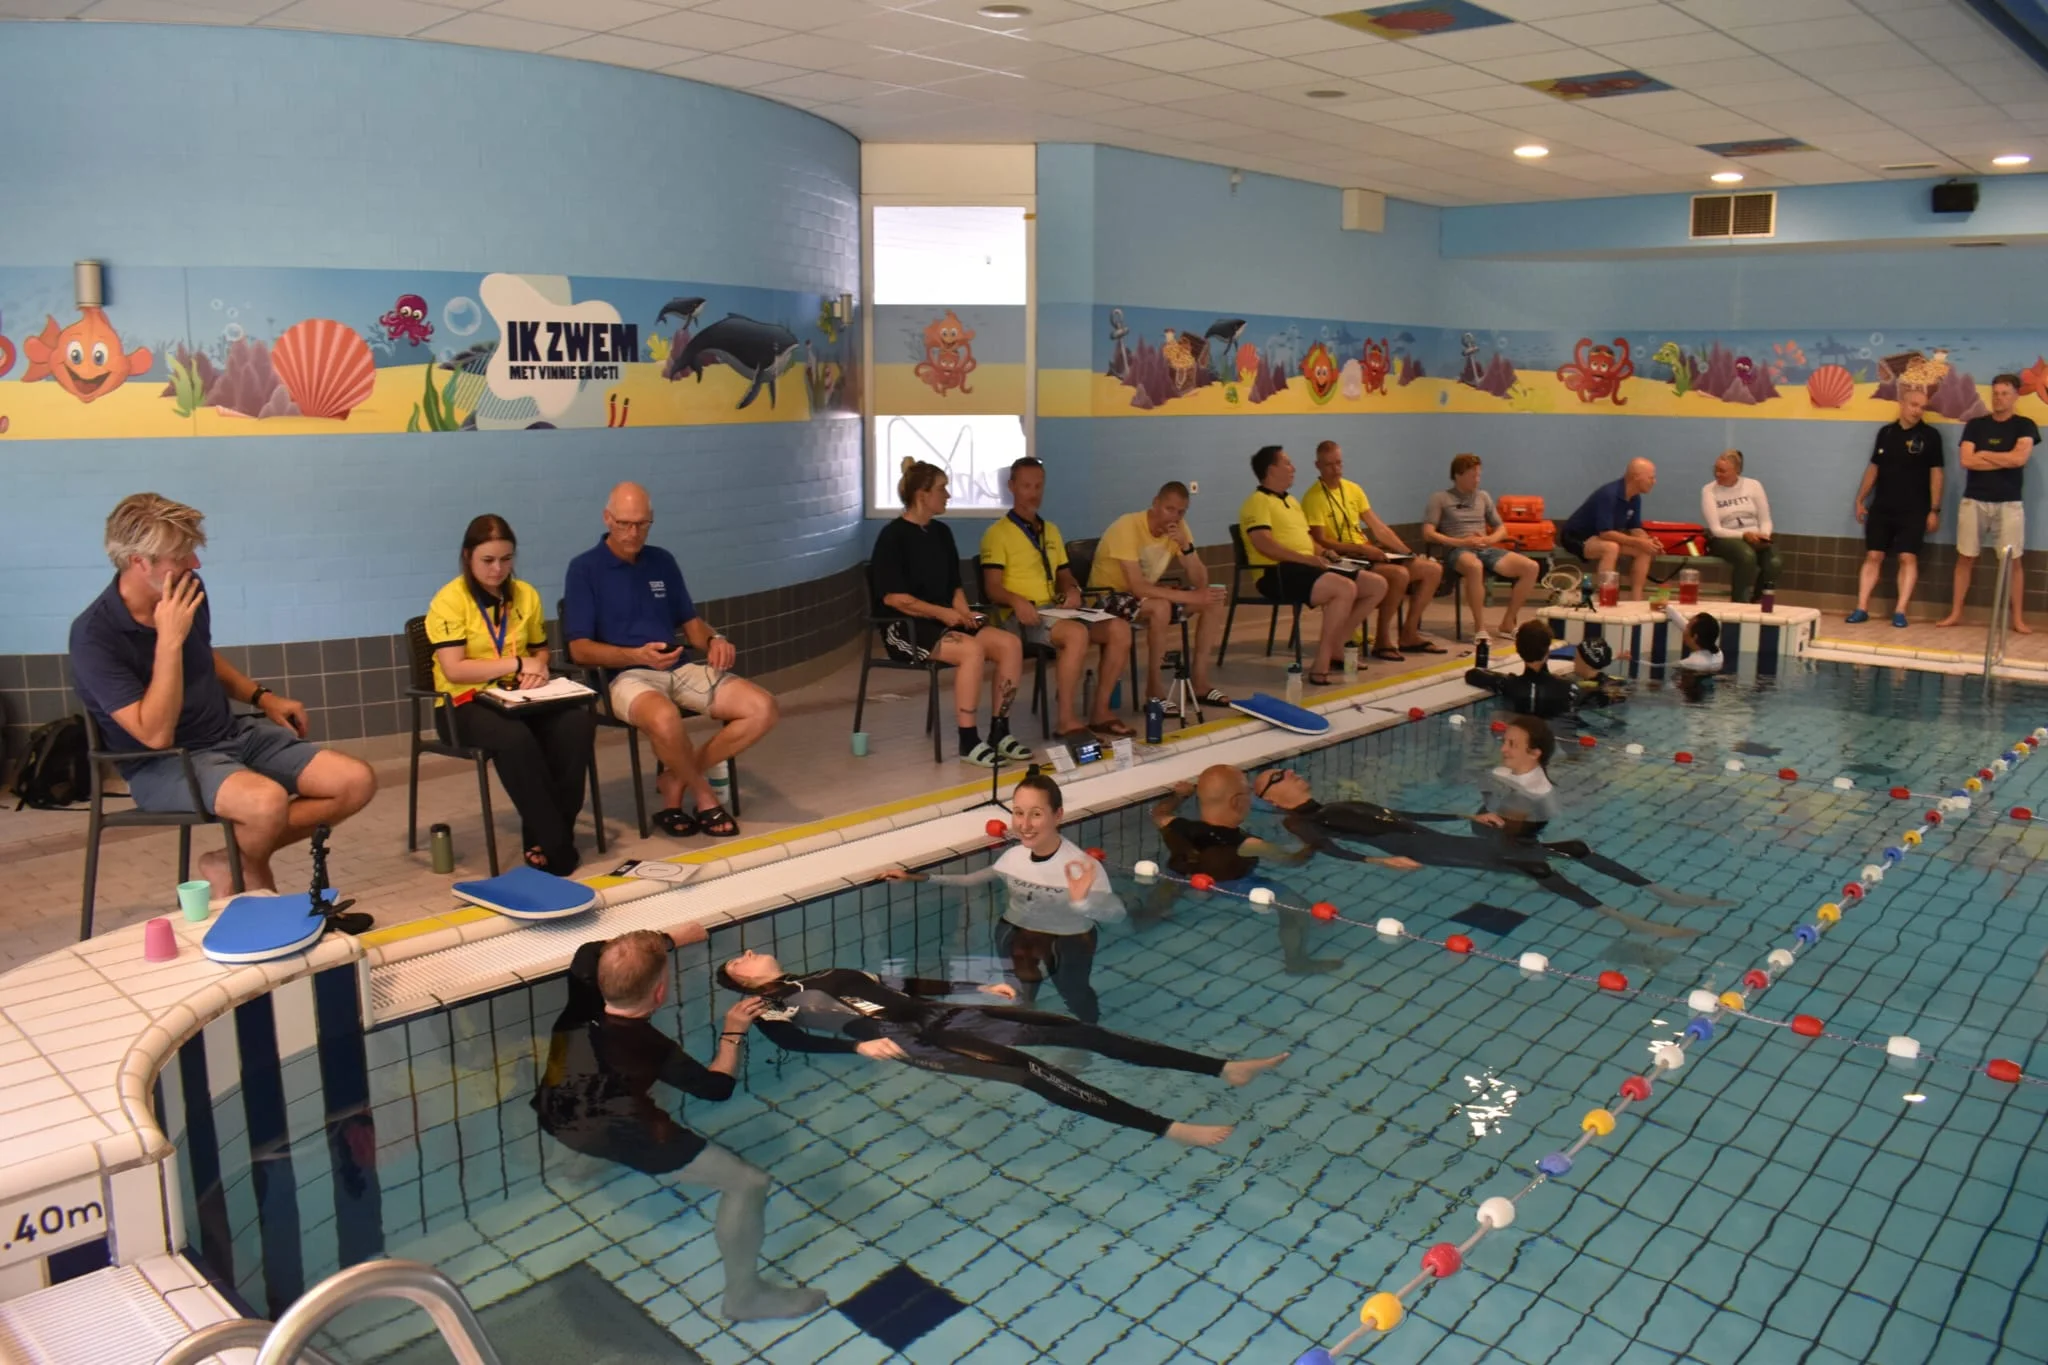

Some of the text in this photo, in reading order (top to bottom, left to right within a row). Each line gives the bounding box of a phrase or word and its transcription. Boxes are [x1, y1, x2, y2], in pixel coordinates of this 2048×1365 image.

[507, 321, 640, 362] IK ZWEM
[509, 365, 619, 380] MET VINNIE EN OCTI
[1716, 496, 1748, 509] SAFETY
